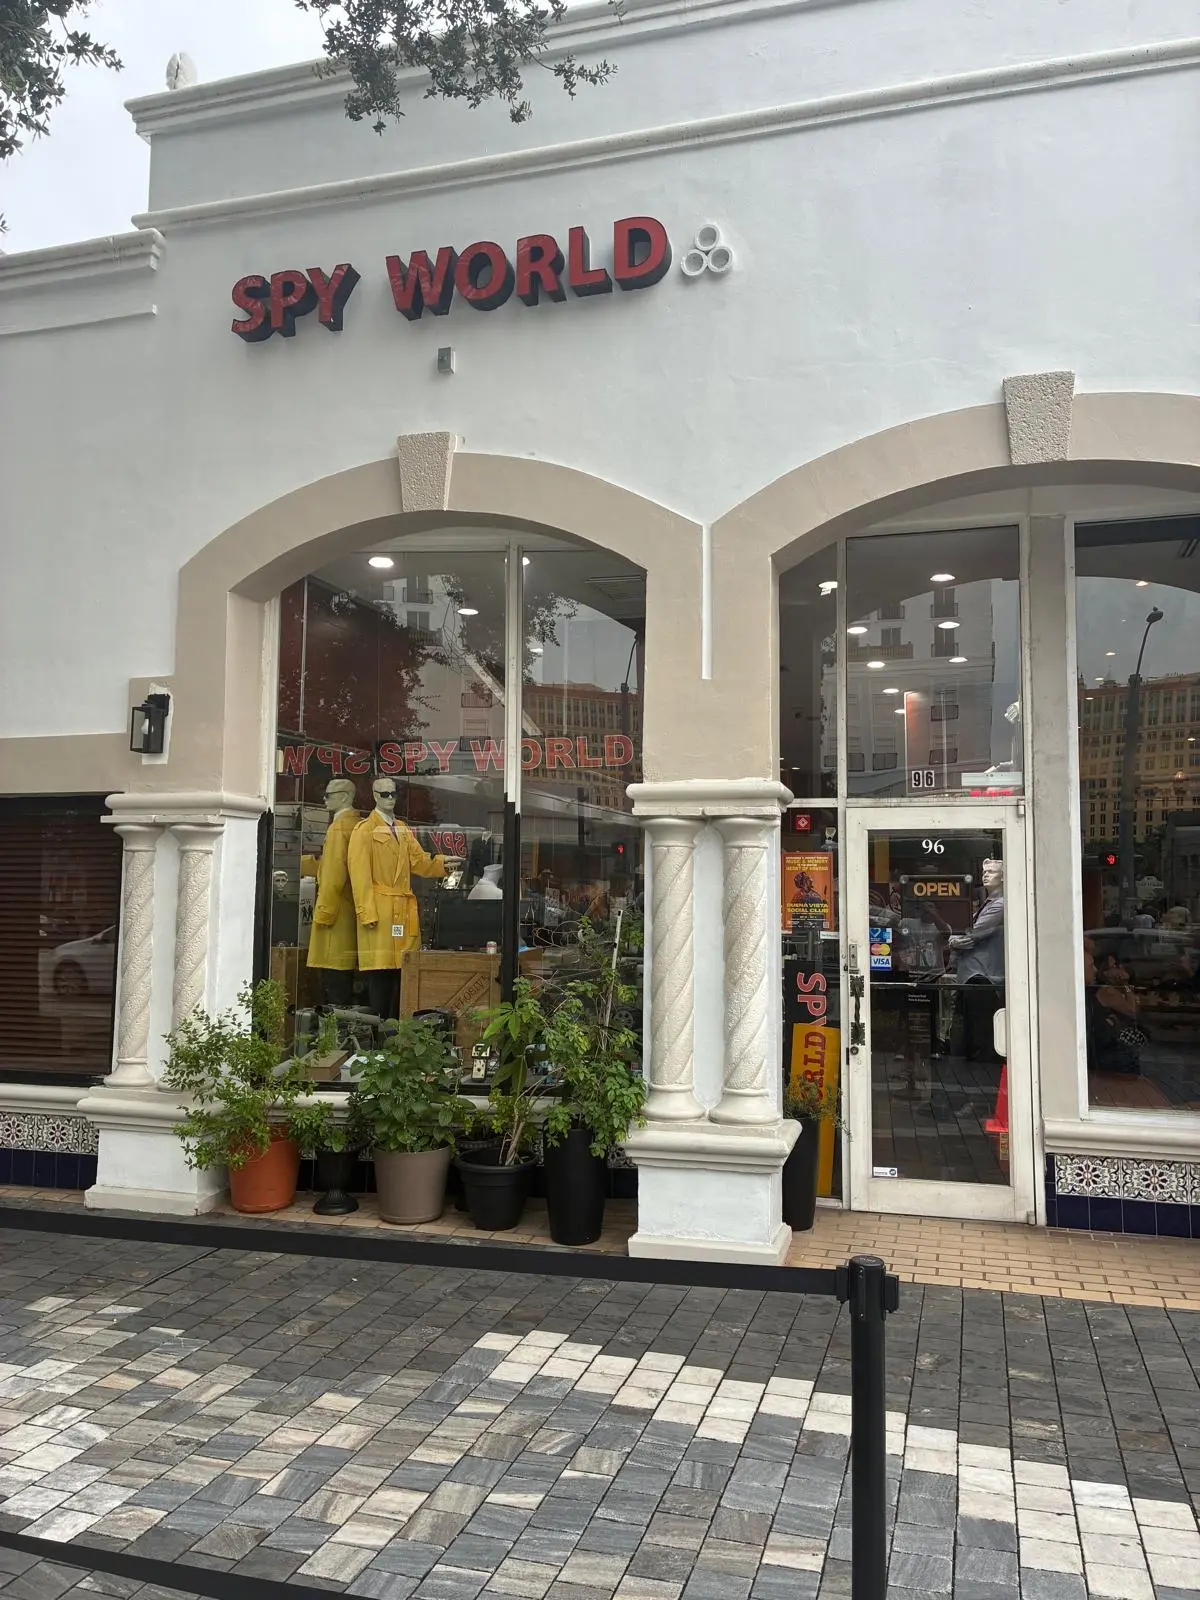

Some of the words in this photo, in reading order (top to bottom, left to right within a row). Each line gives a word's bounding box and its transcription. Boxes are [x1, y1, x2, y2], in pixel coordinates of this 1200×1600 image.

[231, 263, 361, 343] SPY
[386, 215, 672, 321] WORLD
[379, 740, 458, 774] SPY
[470, 734, 634, 772] WORLD
[912, 770, 934, 787] 96
[921, 838, 945, 855] 96
[913, 882, 960, 897] OPEN
[873, 957, 890, 965] VISA
